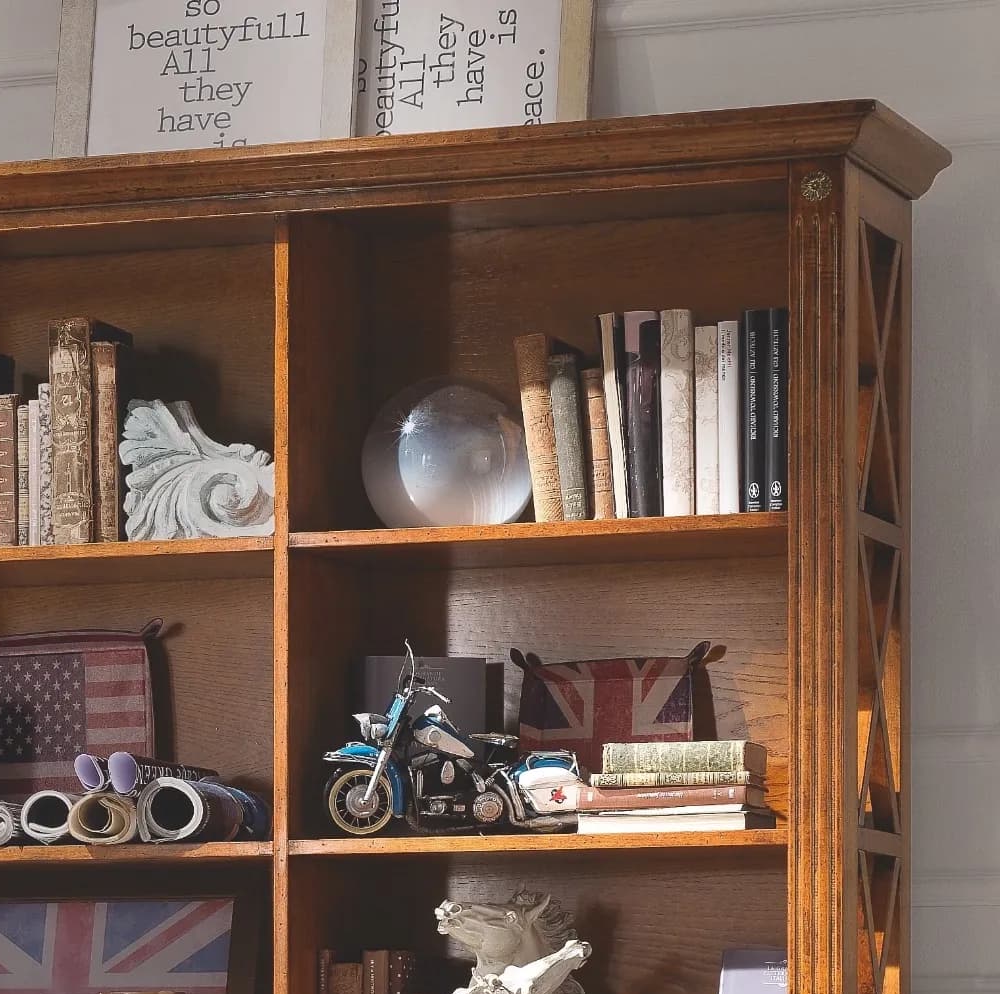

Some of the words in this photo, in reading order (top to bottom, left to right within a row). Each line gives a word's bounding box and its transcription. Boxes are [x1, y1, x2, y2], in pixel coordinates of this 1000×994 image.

[185, 0, 221, 17] so
[490, 8, 517, 45] is
[128, 12, 310, 51] beautyfull
[160, 47, 216, 76] All
[429, 13, 465, 88] they
[456, 29, 487, 107] have
[179, 76, 253, 107] they
[399, 53, 426, 110] All
[157, 107, 232, 133] have
